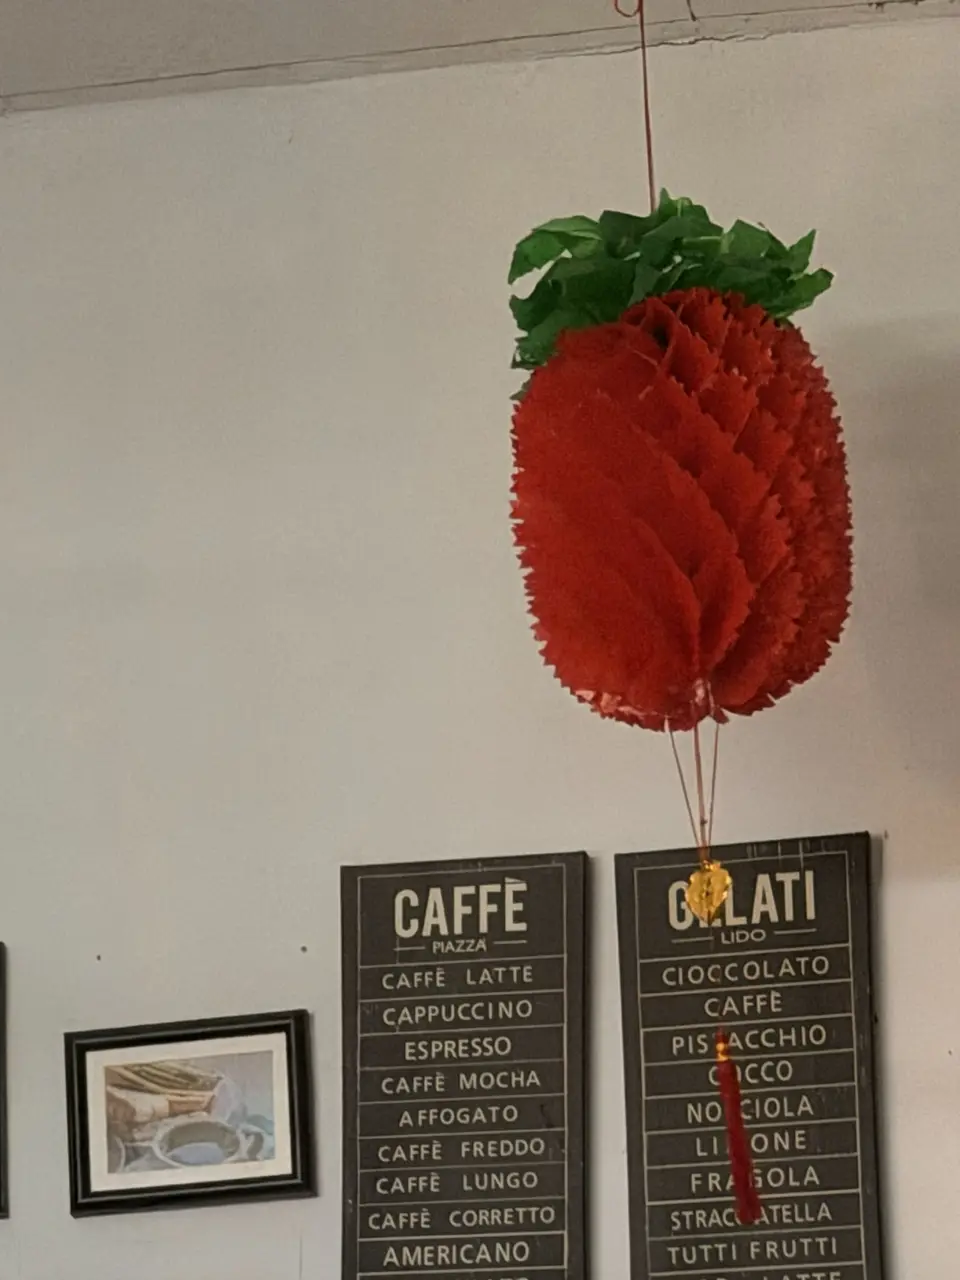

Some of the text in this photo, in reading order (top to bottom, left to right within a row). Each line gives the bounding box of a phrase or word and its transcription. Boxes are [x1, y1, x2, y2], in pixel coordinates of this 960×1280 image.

[394, 877, 528, 938] CAFFÈ
[668, 870, 817, 931] GLATI
[432, 938, 488, 954] PIAZZA
[721, 928, 767, 945] LIDO
[382, 965, 533, 990] CAFFÈ LATTE
[662, 955, 830, 986] CIOCCOLATO
[382, 1000, 533, 1026] CAPPUCCINO
[704, 990, 782, 1017] CAFFÈ
[405, 1036, 511, 1061] ESPRESSO
[672, 1024, 827, 1056] PISACCHIO
[381, 1070, 541, 1095] CAFFÈ MOCHA
[708, 1060, 793, 1086] CCCO
[398, 1105, 518, 1127] AFFOGATO
[687, 1095, 814, 1124] NOCIOLA
[378, 1137, 545, 1163] CAFFÈ FREDDO
[695, 1129, 807, 1157] LIONE
[376, 1171, 538, 1195] CAFFÈ LUNGO
[368, 1206, 556, 1230] CAFFÈ CORRETTO
[670, 1202, 833, 1231] STRACATELLA
[383, 1241, 530, 1267] AMERICANO
[667, 1237, 837, 1265] TUTTI FRUTTI
